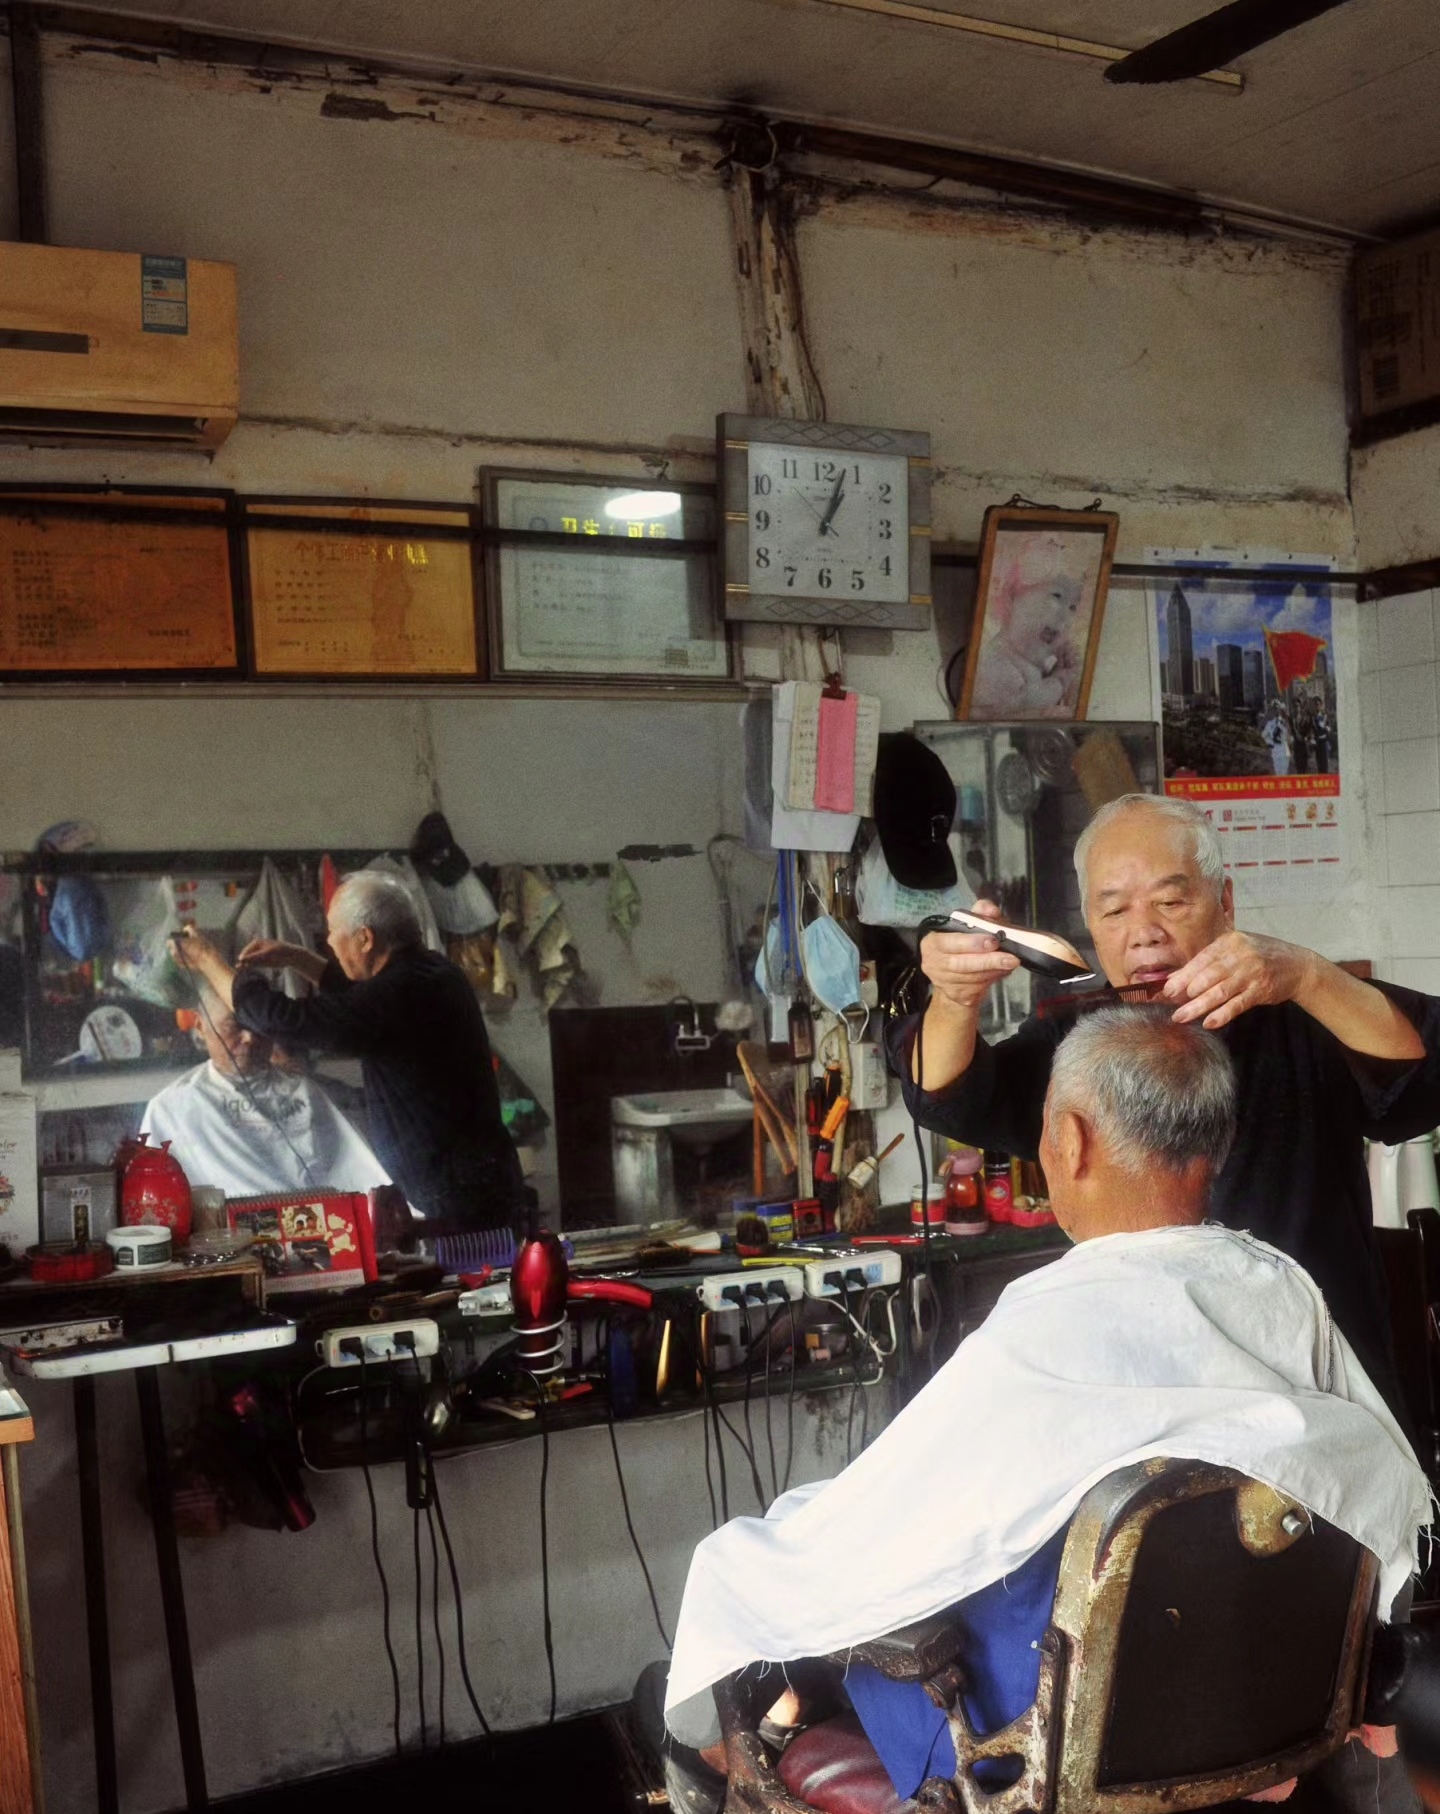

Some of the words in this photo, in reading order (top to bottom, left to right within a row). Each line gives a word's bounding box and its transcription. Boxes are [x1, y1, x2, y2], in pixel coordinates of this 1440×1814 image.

[783, 459, 798, 479] 11
[814, 462, 836, 483] 12
[853, 464, 861, 485] 1
[754, 474, 772, 496] 10
[878, 483, 892, 504] 2
[755, 510, 770, 531] 9
[879, 519, 892, 540] 3
[756, 547, 770, 568] 8
[879, 555, 892, 576] 4
[783, 566, 797, 587] 7
[818, 568, 832, 589] 6
[851, 569, 865, 590] 5
